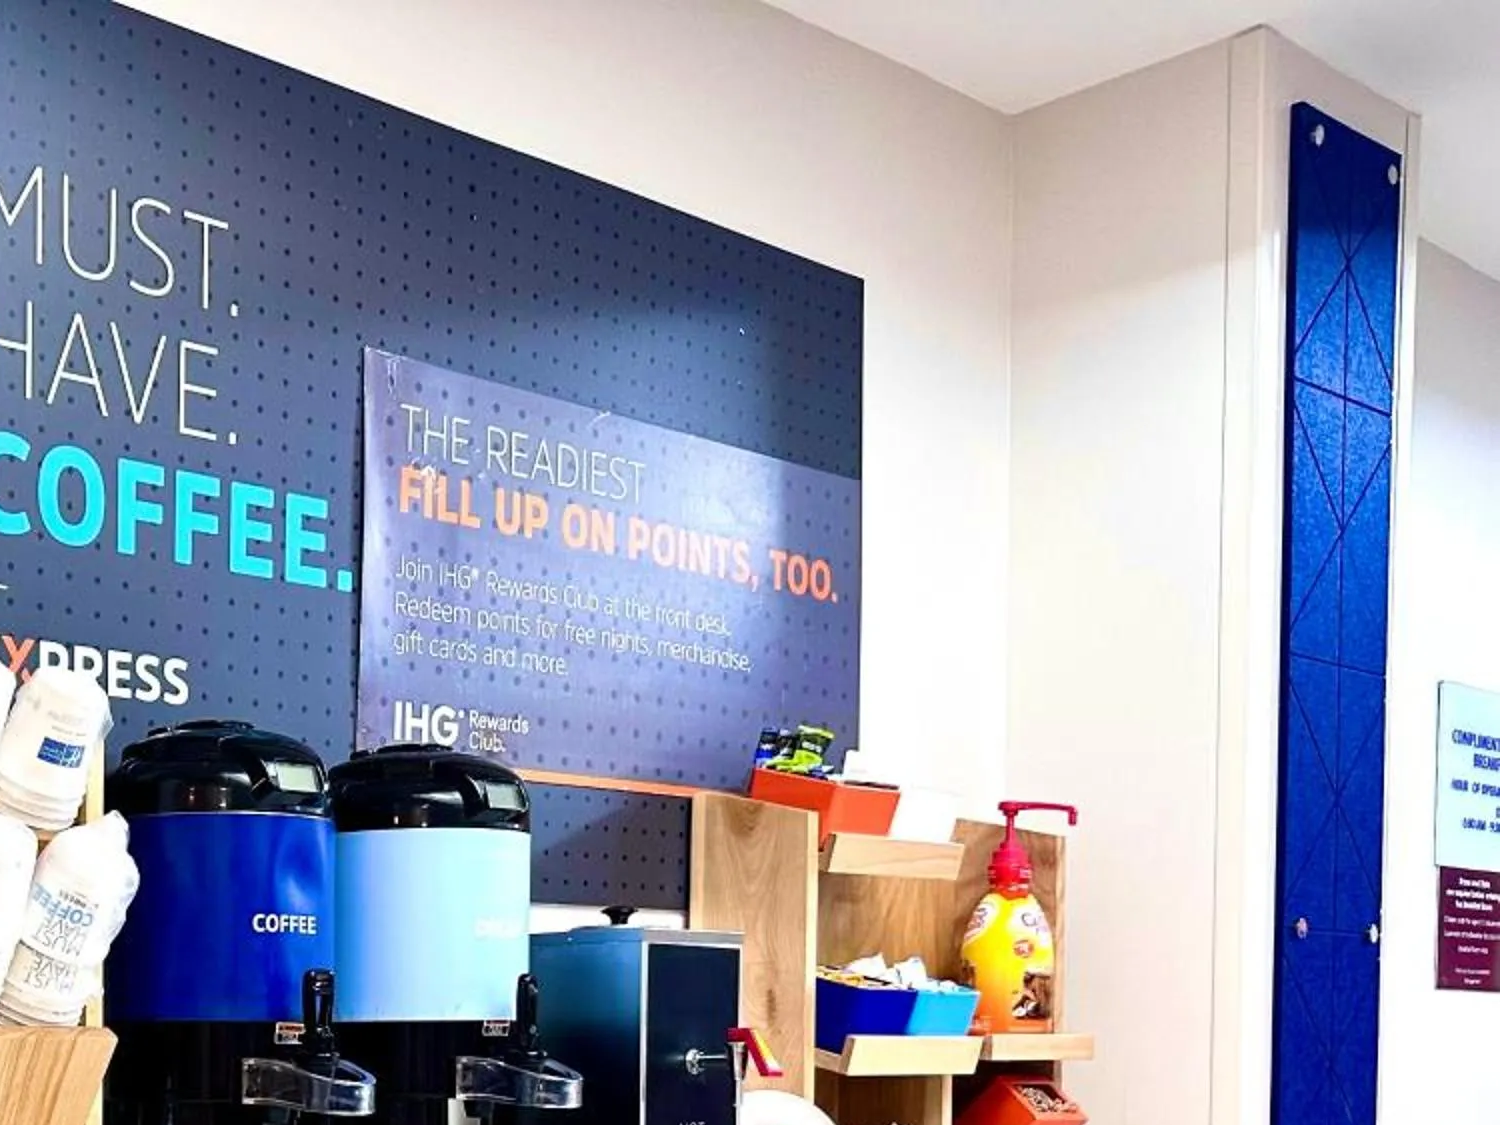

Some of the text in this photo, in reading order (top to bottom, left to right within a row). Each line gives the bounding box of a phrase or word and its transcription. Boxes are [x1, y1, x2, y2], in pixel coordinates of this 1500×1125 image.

[400, 403, 646, 502] THE READIEST
[399, 465, 839, 605] FILL UP ON POINTS, TOO.
[395, 554, 433, 582] Join
[486, 571, 559, 605] Rewards
[563, 585, 599, 612] Club
[603, 596, 620, 618] at
[625, 597, 651, 623] the
[655, 604, 691, 630] front
[395, 591, 471, 625] Redeem
[476, 609, 531, 634] points
[536, 613, 559, 640] for
[563, 619, 596, 646] free
[393, 630, 569, 676] gift cards and more.
[468, 709, 530, 735] Rewards
[252, 913, 317, 935] COFFEE
